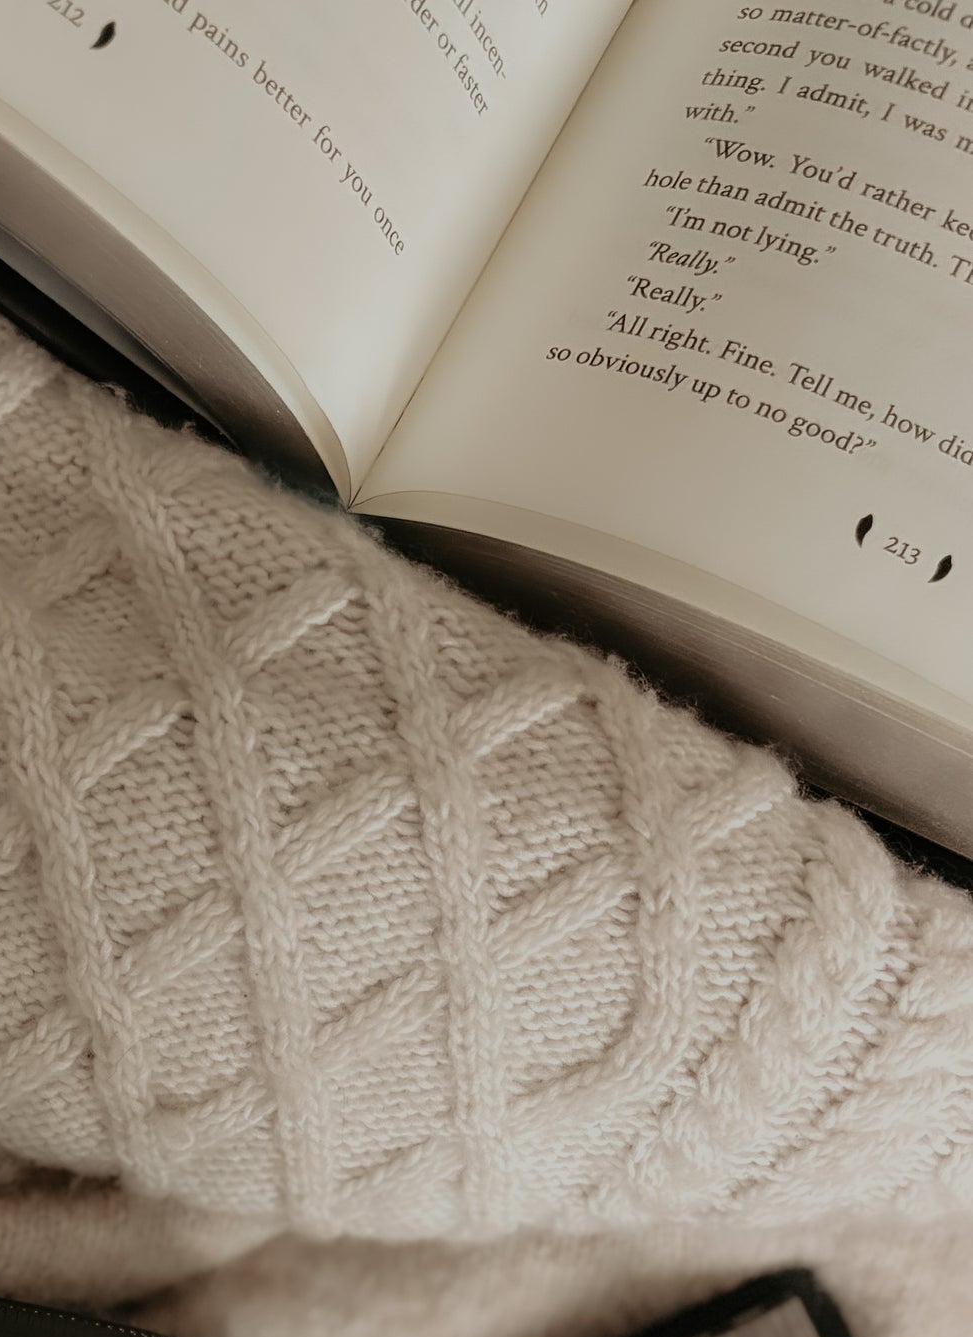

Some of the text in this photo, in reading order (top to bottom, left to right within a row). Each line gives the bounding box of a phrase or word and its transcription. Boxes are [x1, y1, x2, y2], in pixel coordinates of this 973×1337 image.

[47, 0, 84, 27] 212
[470, 14, 505, 79] incen-
[737, 8, 763, 19] so
[769, 9, 957, 67] matter-of-factly,
[411, 0, 488, 115] der or faster
[719, 40, 800, 58] second
[804, 50, 851, 69] you
[865, 62, 950, 100] walked
[187, 12, 404, 255] pains better for you once
[686, 103, 755, 123] with.”
[702, 68, 947, 141] thing. I admit, I was
[705, 137, 775, 168] “Wow.
[789, 154, 857, 190] You’d
[859, 183, 936, 220] rather
[643, 168, 692, 190] hole
[697, 176, 749, 201] than
[755, 191, 826, 223] admit
[829, 209, 868, 238] the
[873, 228, 937, 267] truth.
[666, 206, 837, 267] “I’m not lying.”
[546, 346, 877, 454] so obviously up to no good?”
[606, 311, 644, 336] “All
[651, 324, 710, 354] right.
[718, 340, 775, 376] Fine.
[788, 363, 834, 398] Tell
[833, 390, 875, 421] me,
[880, 404, 936, 443] how
[883, 537, 921, 564] 213
